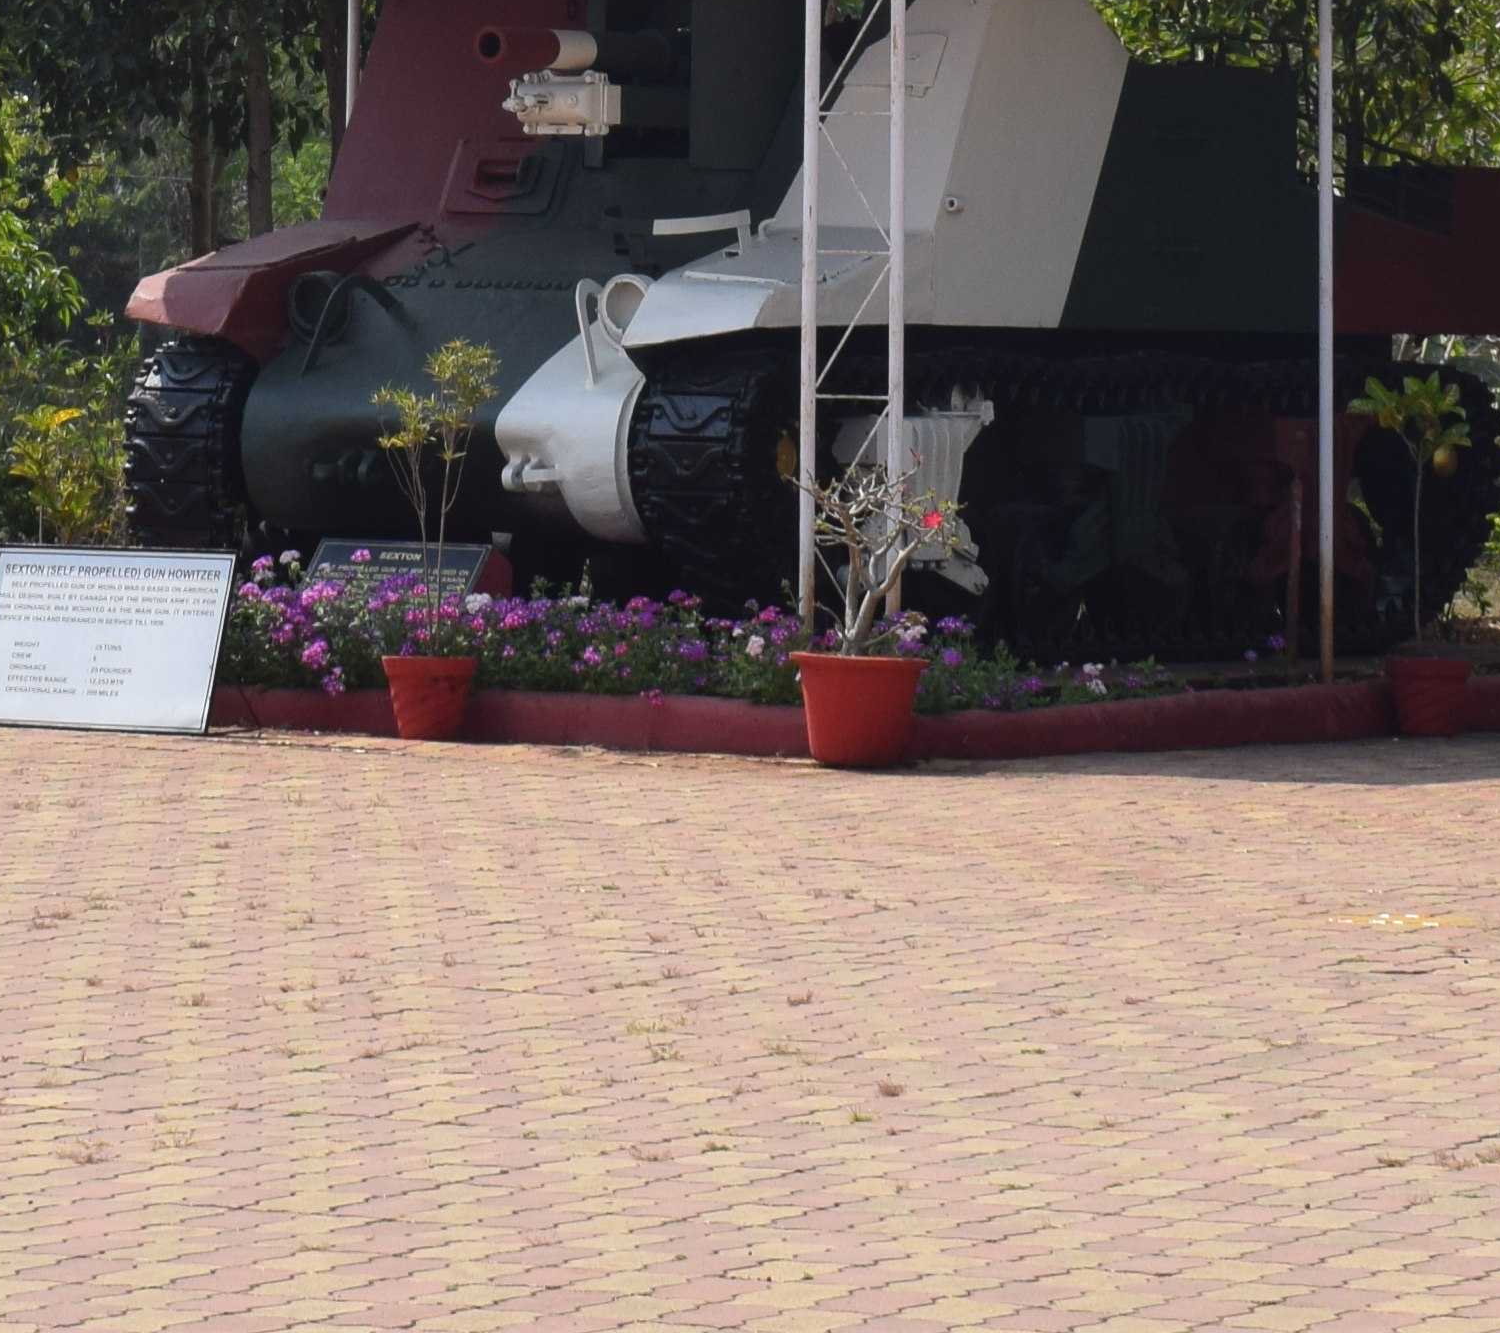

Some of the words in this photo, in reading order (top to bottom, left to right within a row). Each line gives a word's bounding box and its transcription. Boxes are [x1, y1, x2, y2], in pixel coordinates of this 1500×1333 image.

[380, 551, 422, 561] SEXTON
[5, 563, 45, 576] SEXTON
[46, 564, 75, 578] (SELF
[78, 566, 141, 580] PROPELLED)
[144, 567, 165, 579] GUN
[168, 568, 221, 581] HOWITZER
